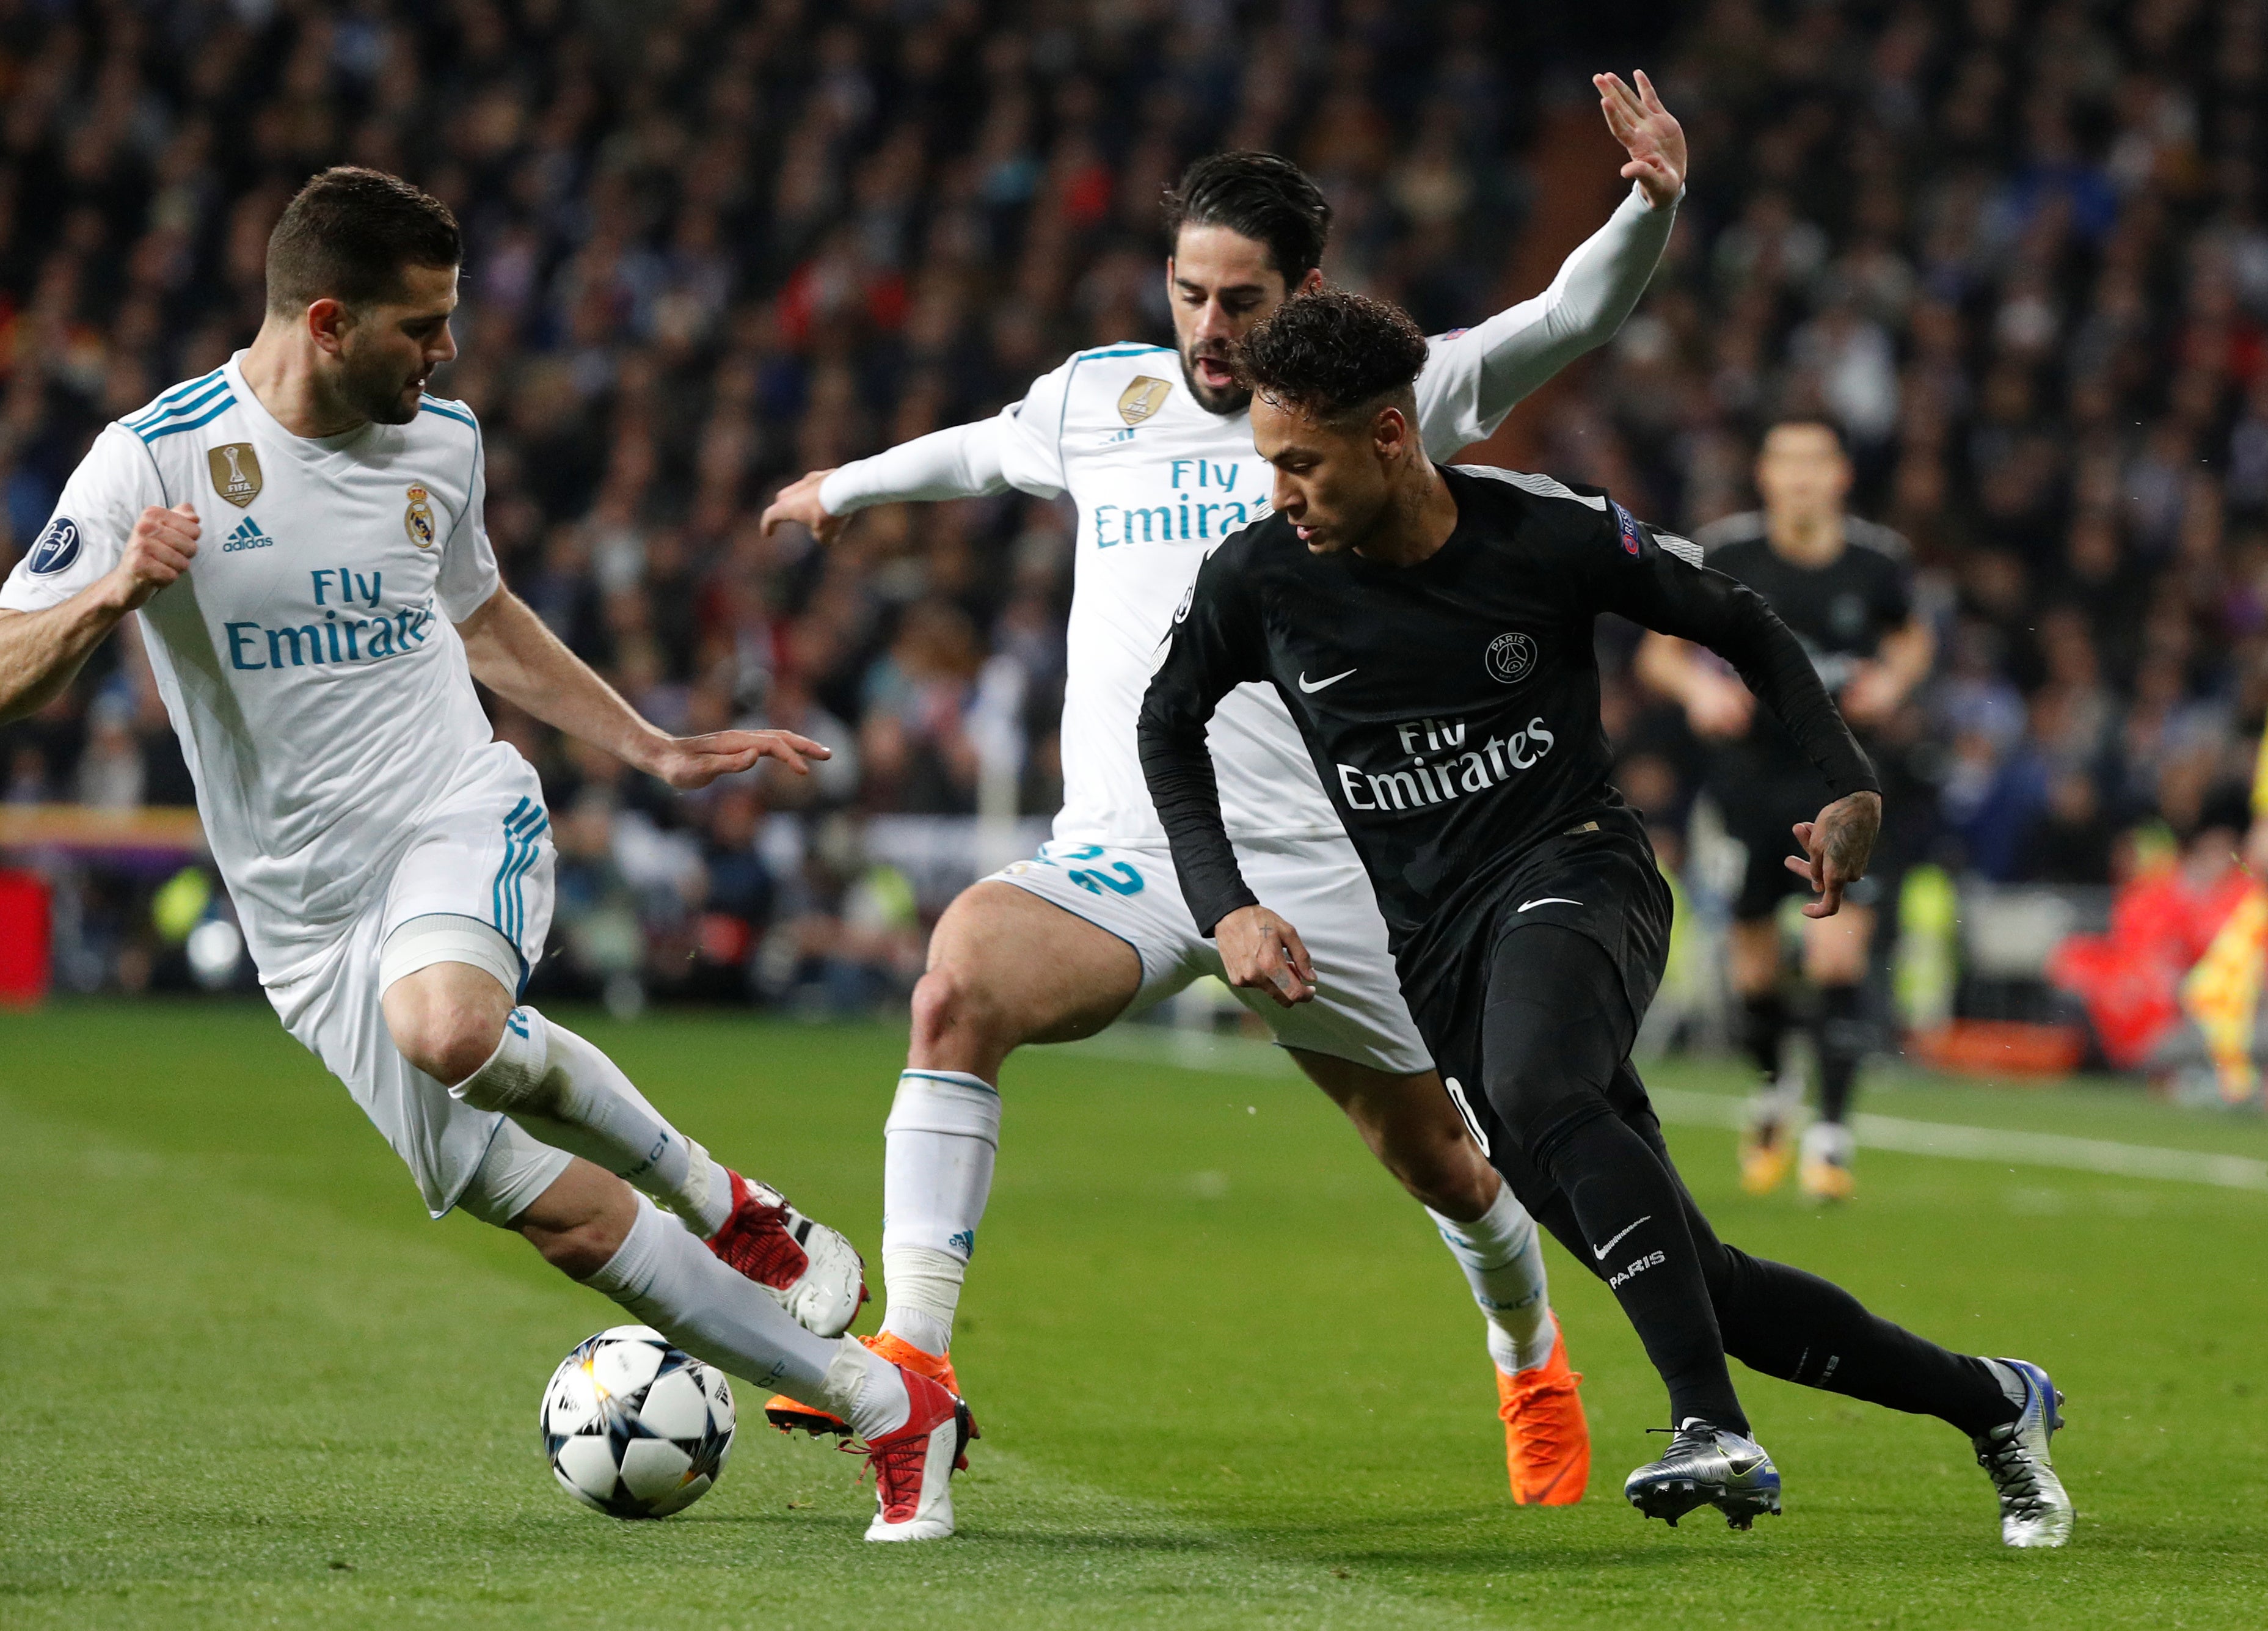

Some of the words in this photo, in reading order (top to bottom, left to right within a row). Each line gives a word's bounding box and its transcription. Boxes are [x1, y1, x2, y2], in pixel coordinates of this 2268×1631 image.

[227, 482, 252, 493] FIFA
[1171, 459, 1239, 493] Fly
[1095, 492, 1266, 549] Emira
[222, 536, 273, 553] adidas
[310, 567, 381, 608] Fly
[1491, 635, 1526, 651] PARIS
[1395, 717, 1466, 755] Fly
[1336, 717, 1555, 811] Emirates
[1610, 1250, 1666, 1290] PARIS
